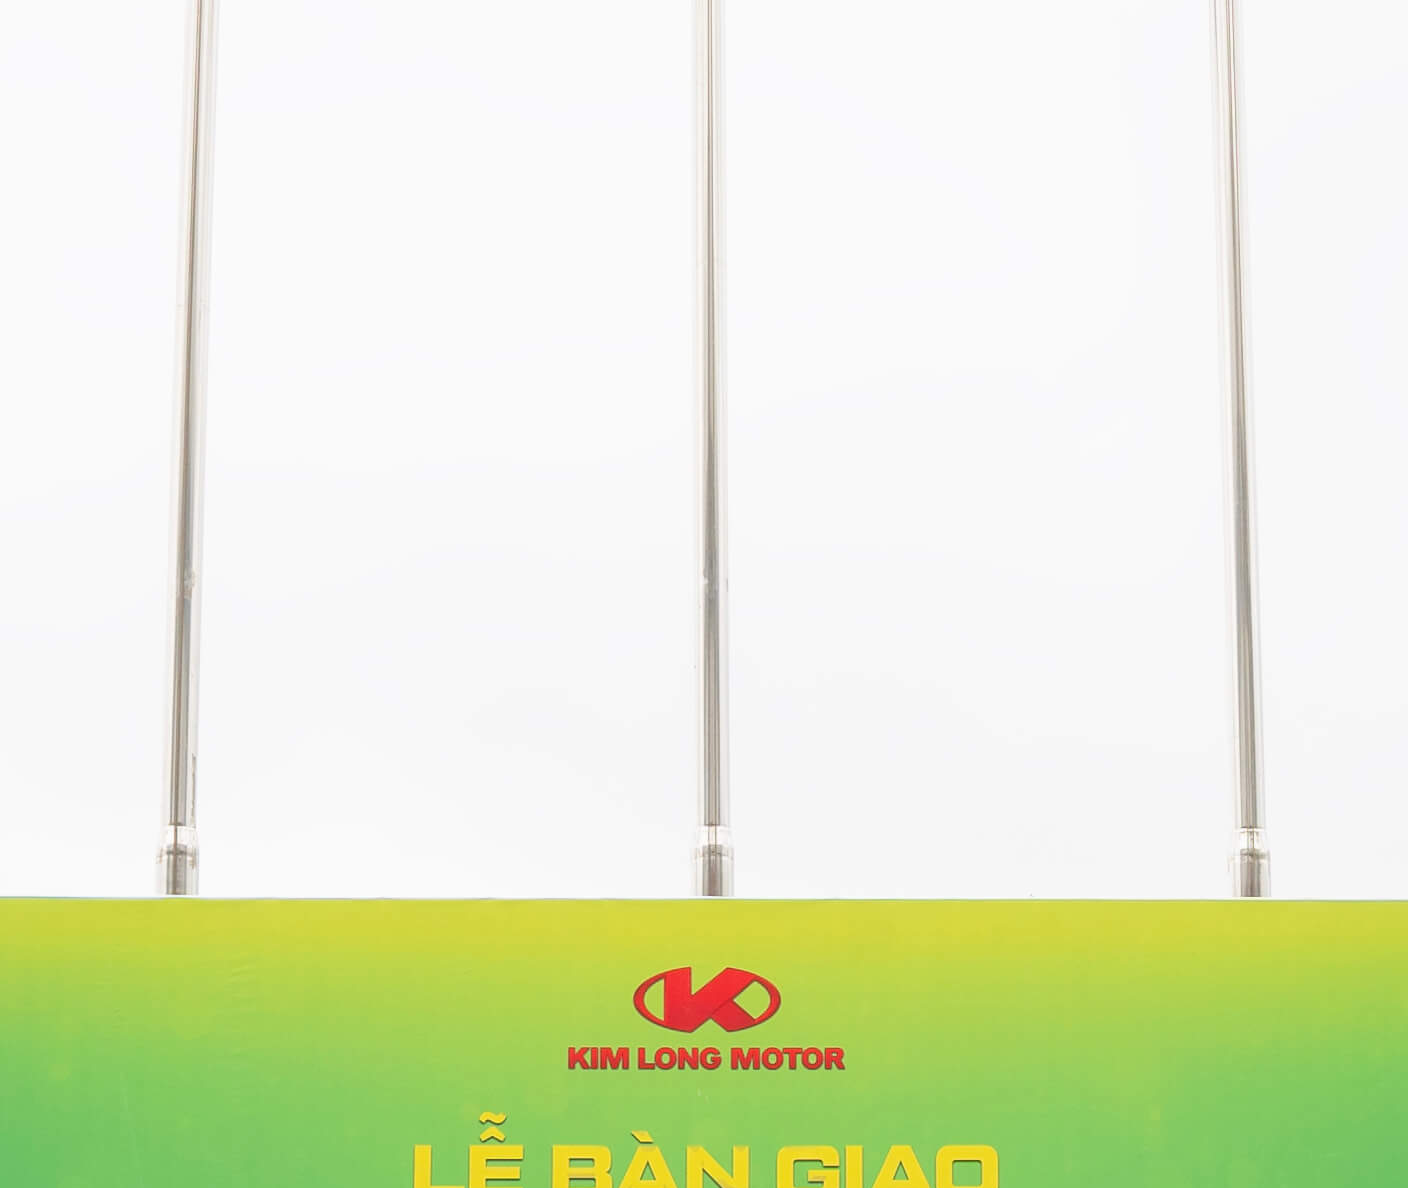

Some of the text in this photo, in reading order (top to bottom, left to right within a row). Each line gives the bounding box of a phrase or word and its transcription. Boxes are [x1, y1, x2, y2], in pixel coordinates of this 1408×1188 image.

[568, 1047, 845, 1070] KIM LONG MOTOR
